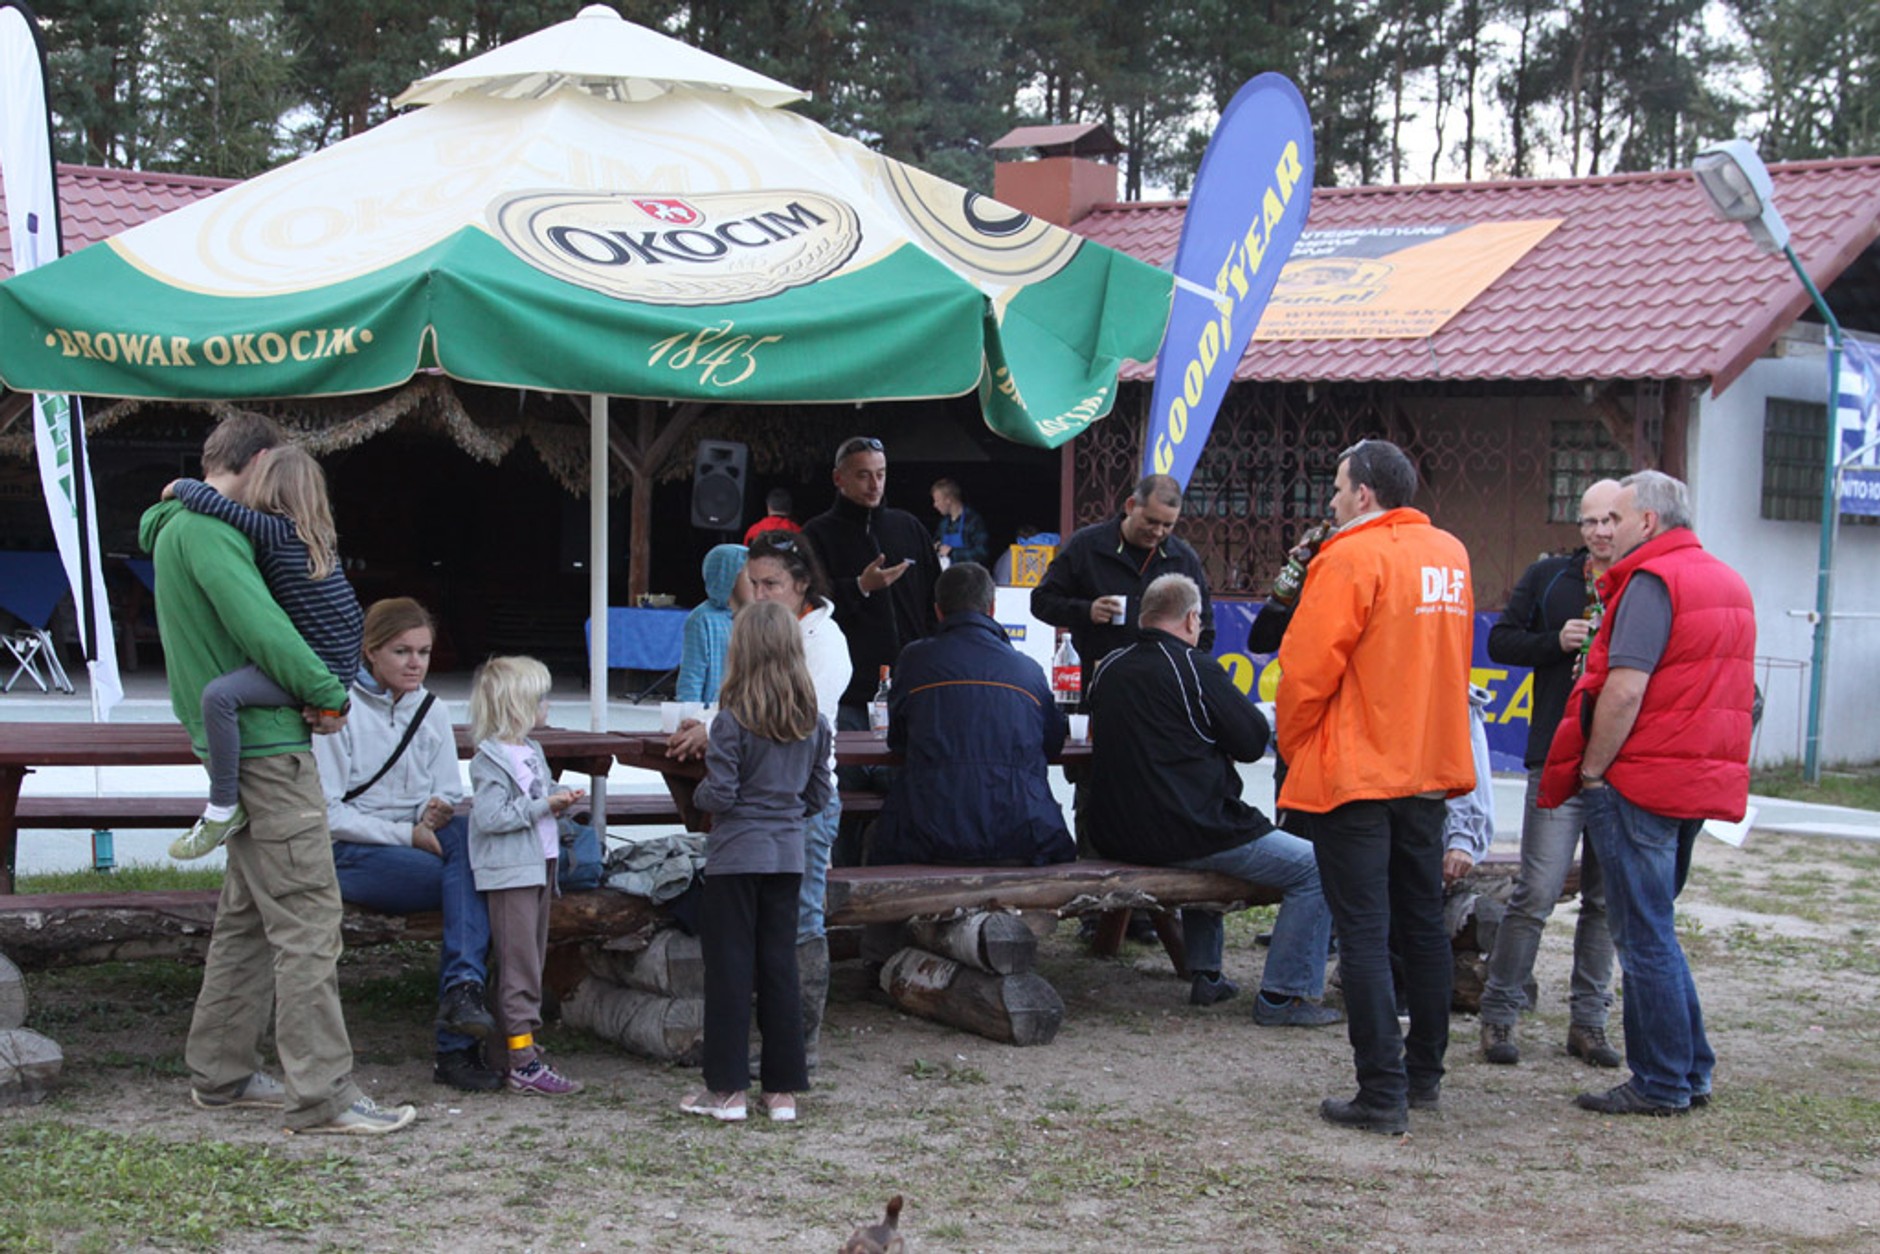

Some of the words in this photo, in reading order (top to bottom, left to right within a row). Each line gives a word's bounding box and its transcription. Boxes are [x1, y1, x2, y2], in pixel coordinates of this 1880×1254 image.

[546, 202, 828, 266] OKOCIM
[54, 328, 196, 367] BROWAR
[203, 326, 359, 365] OKOCIM
[647, 320, 784, 388] 1845
[1421, 565, 1465, 603] DLF
